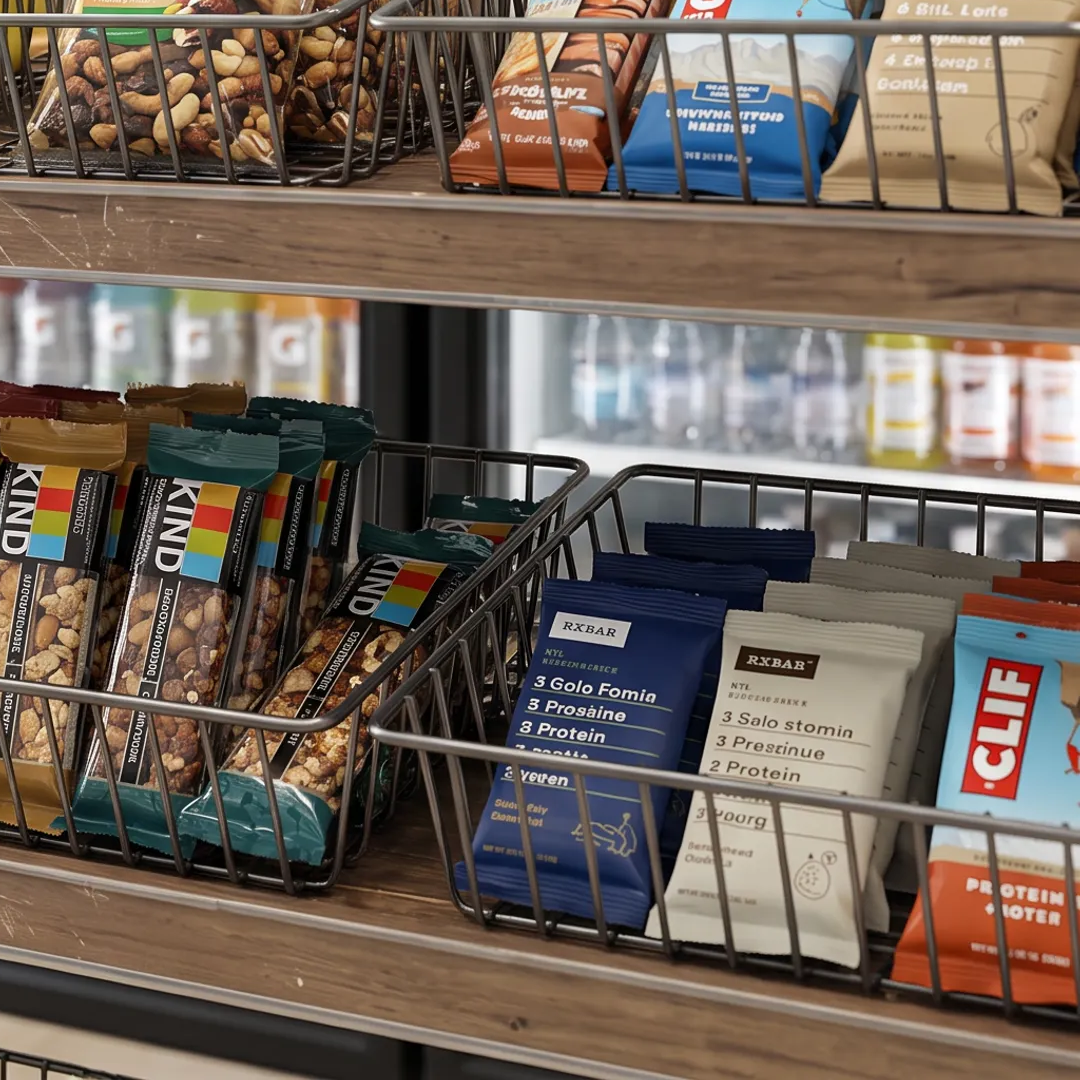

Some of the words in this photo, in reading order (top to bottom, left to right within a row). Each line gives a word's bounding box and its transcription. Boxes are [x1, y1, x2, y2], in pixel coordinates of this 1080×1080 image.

[2, 462, 45, 555] KIND
[155, 477, 203, 573] KIND
[348, 554, 406, 616] KIND
[562, 621, 617, 638] RXBAR
[746, 654, 806, 671] RXBAR
[533, 675, 546, 688] 3
[549, 677, 594, 695] Golo
[527, 698, 540, 711] 3
[536, 722, 606, 744] Protein
[721, 710, 733, 723] 3
[737, 712, 779, 729] Salo
[784, 719, 854, 739] stomin
[972, 666, 1032, 782] CLIF
[716, 735, 727, 747] 3
[709, 760, 721, 773] 2
[726, 760, 802, 783] Protein
[966, 876, 1065, 907] PROTEIN
